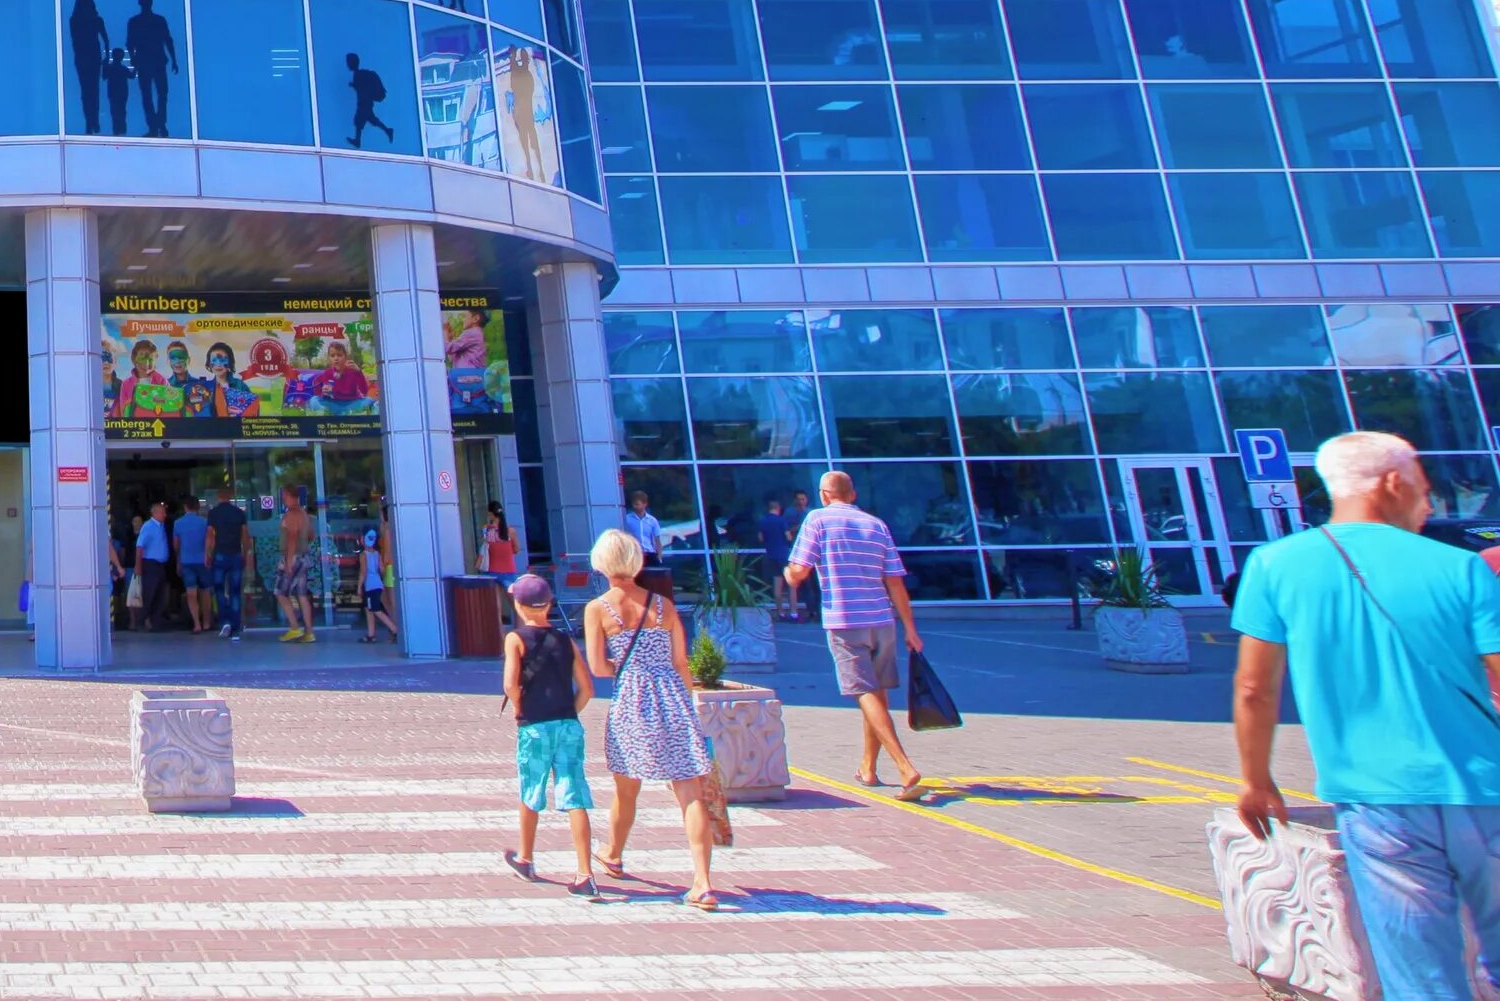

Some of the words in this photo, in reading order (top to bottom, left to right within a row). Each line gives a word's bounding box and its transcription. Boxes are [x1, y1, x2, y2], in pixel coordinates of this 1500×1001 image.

[284, 297, 353, 311] немецкий
[441, 297, 488, 307] чества
[131, 321, 174, 334] Лучшие
[196, 318, 283, 330] ортопедические
[301, 326, 338, 337] ранцы
[264, 349, 273, 361] 3
[104, 420, 151, 430] ürnberg»
[1247, 435, 1278, 476] P
